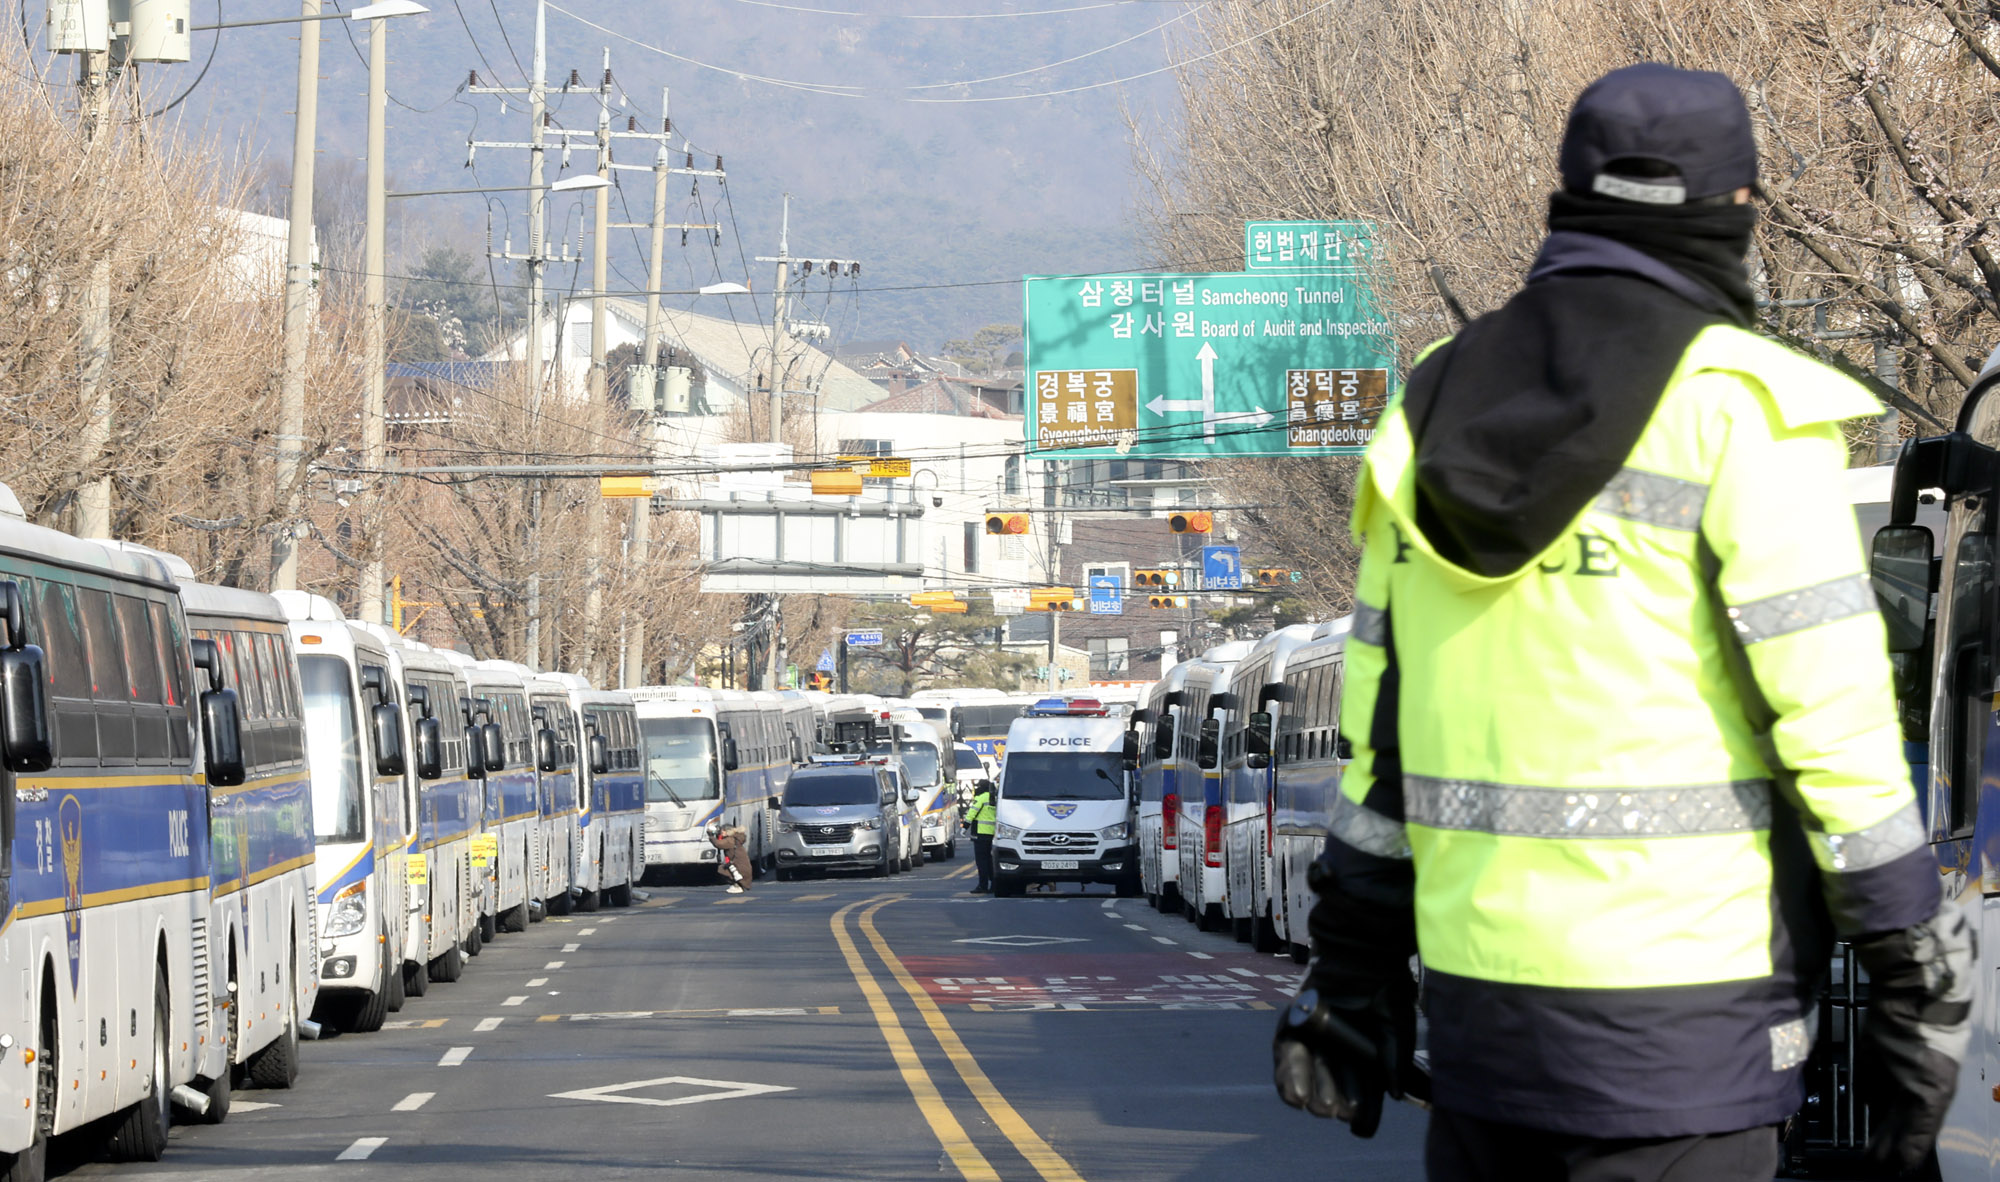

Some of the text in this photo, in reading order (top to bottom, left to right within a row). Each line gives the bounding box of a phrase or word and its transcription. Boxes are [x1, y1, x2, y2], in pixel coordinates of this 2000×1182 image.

[1078, 279, 1195, 307] 삼청터널
[1201, 287, 1344, 308] Samcheong Tunnel
[1109, 311, 1196, 339] 감사원
[1201, 318, 1391, 339] Board of Audit and Inspection
[1039, 372, 1114, 399] 경복궁
[1290, 371, 1360, 398] 창덕궁
[1039, 400, 1115, 424] 景福宮
[1205, 576, 1240, 589] 비보호
[1091, 601, 1121, 612] 비보호
[1038, 737, 1092, 747] POLICE
[35, 816, 54, 875] 경찰
[168, 809, 190, 858] POLICE
